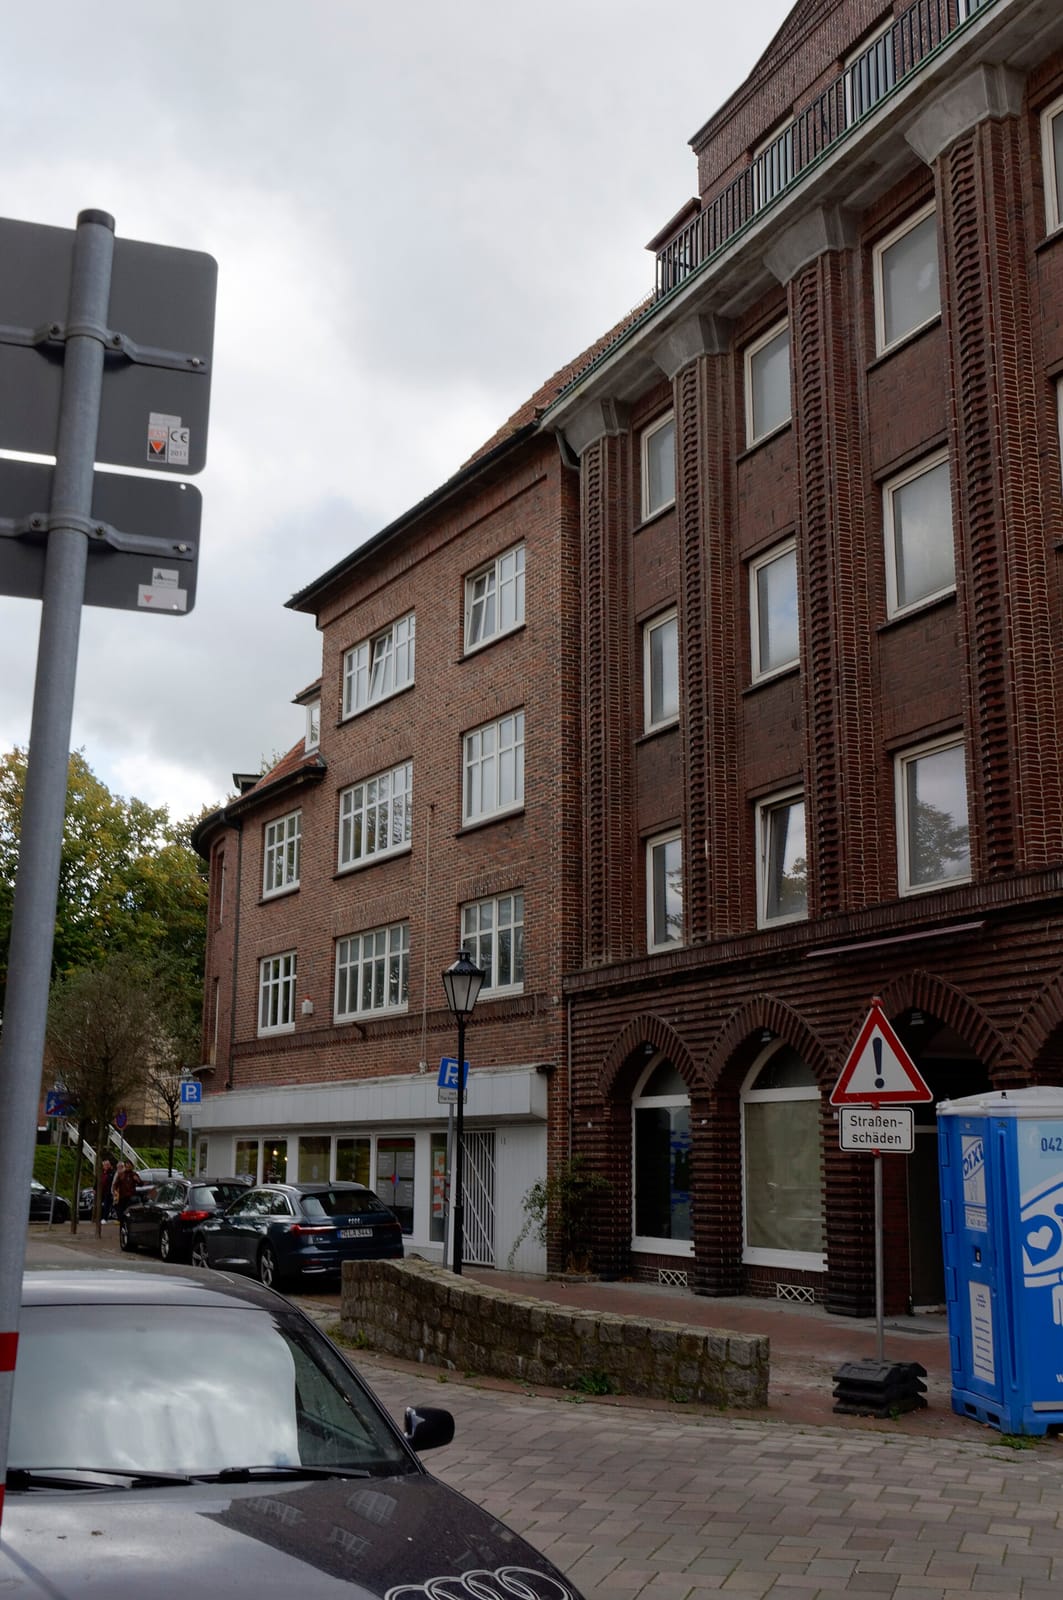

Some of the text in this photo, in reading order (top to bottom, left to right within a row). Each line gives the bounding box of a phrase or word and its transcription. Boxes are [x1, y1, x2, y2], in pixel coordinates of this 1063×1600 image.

[170, 430, 188, 443] CE
[185, 1085, 197, 1101] P
[850, 1115, 903, 1128] Straßen-
[852, 1132, 902, 1144] schäden
